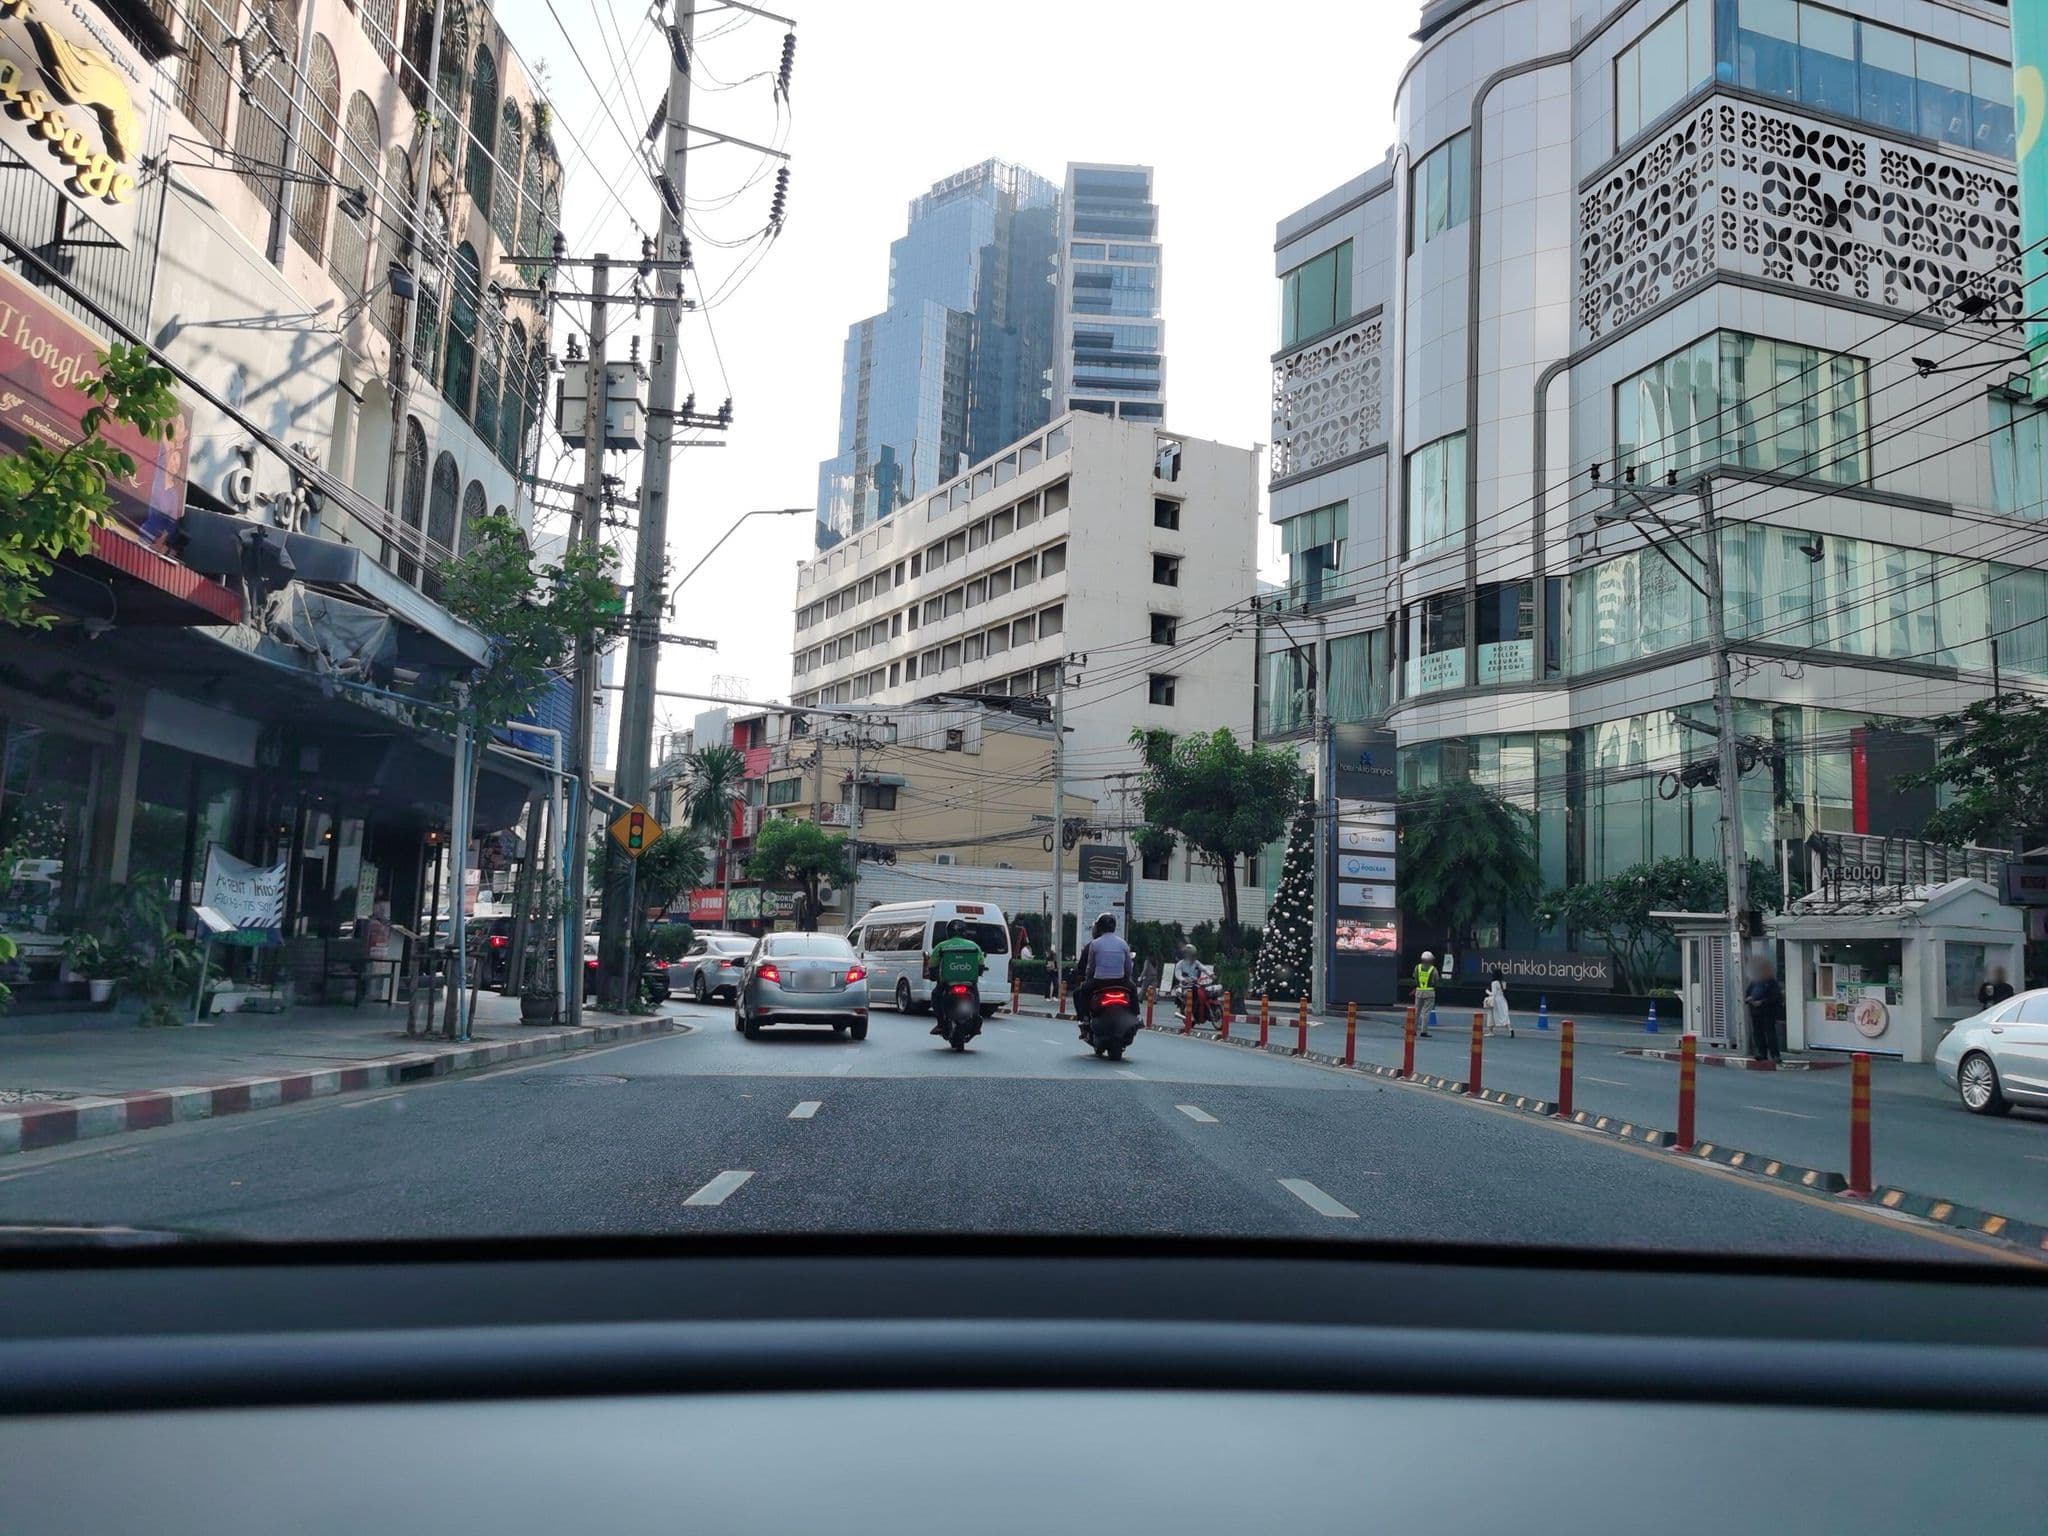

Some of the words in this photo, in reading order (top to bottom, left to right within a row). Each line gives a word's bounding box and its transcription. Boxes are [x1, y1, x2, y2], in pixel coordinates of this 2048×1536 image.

[1493, 651, 1518, 659] FILLER
[1424, 670, 1458, 682] REMOVAL
[1844, 866, 1881, 880] COCO
[949, 962, 972, 972] Grab
[1514, 959, 1547, 976] nikko
[1549, 960, 1607, 982] bangkok
